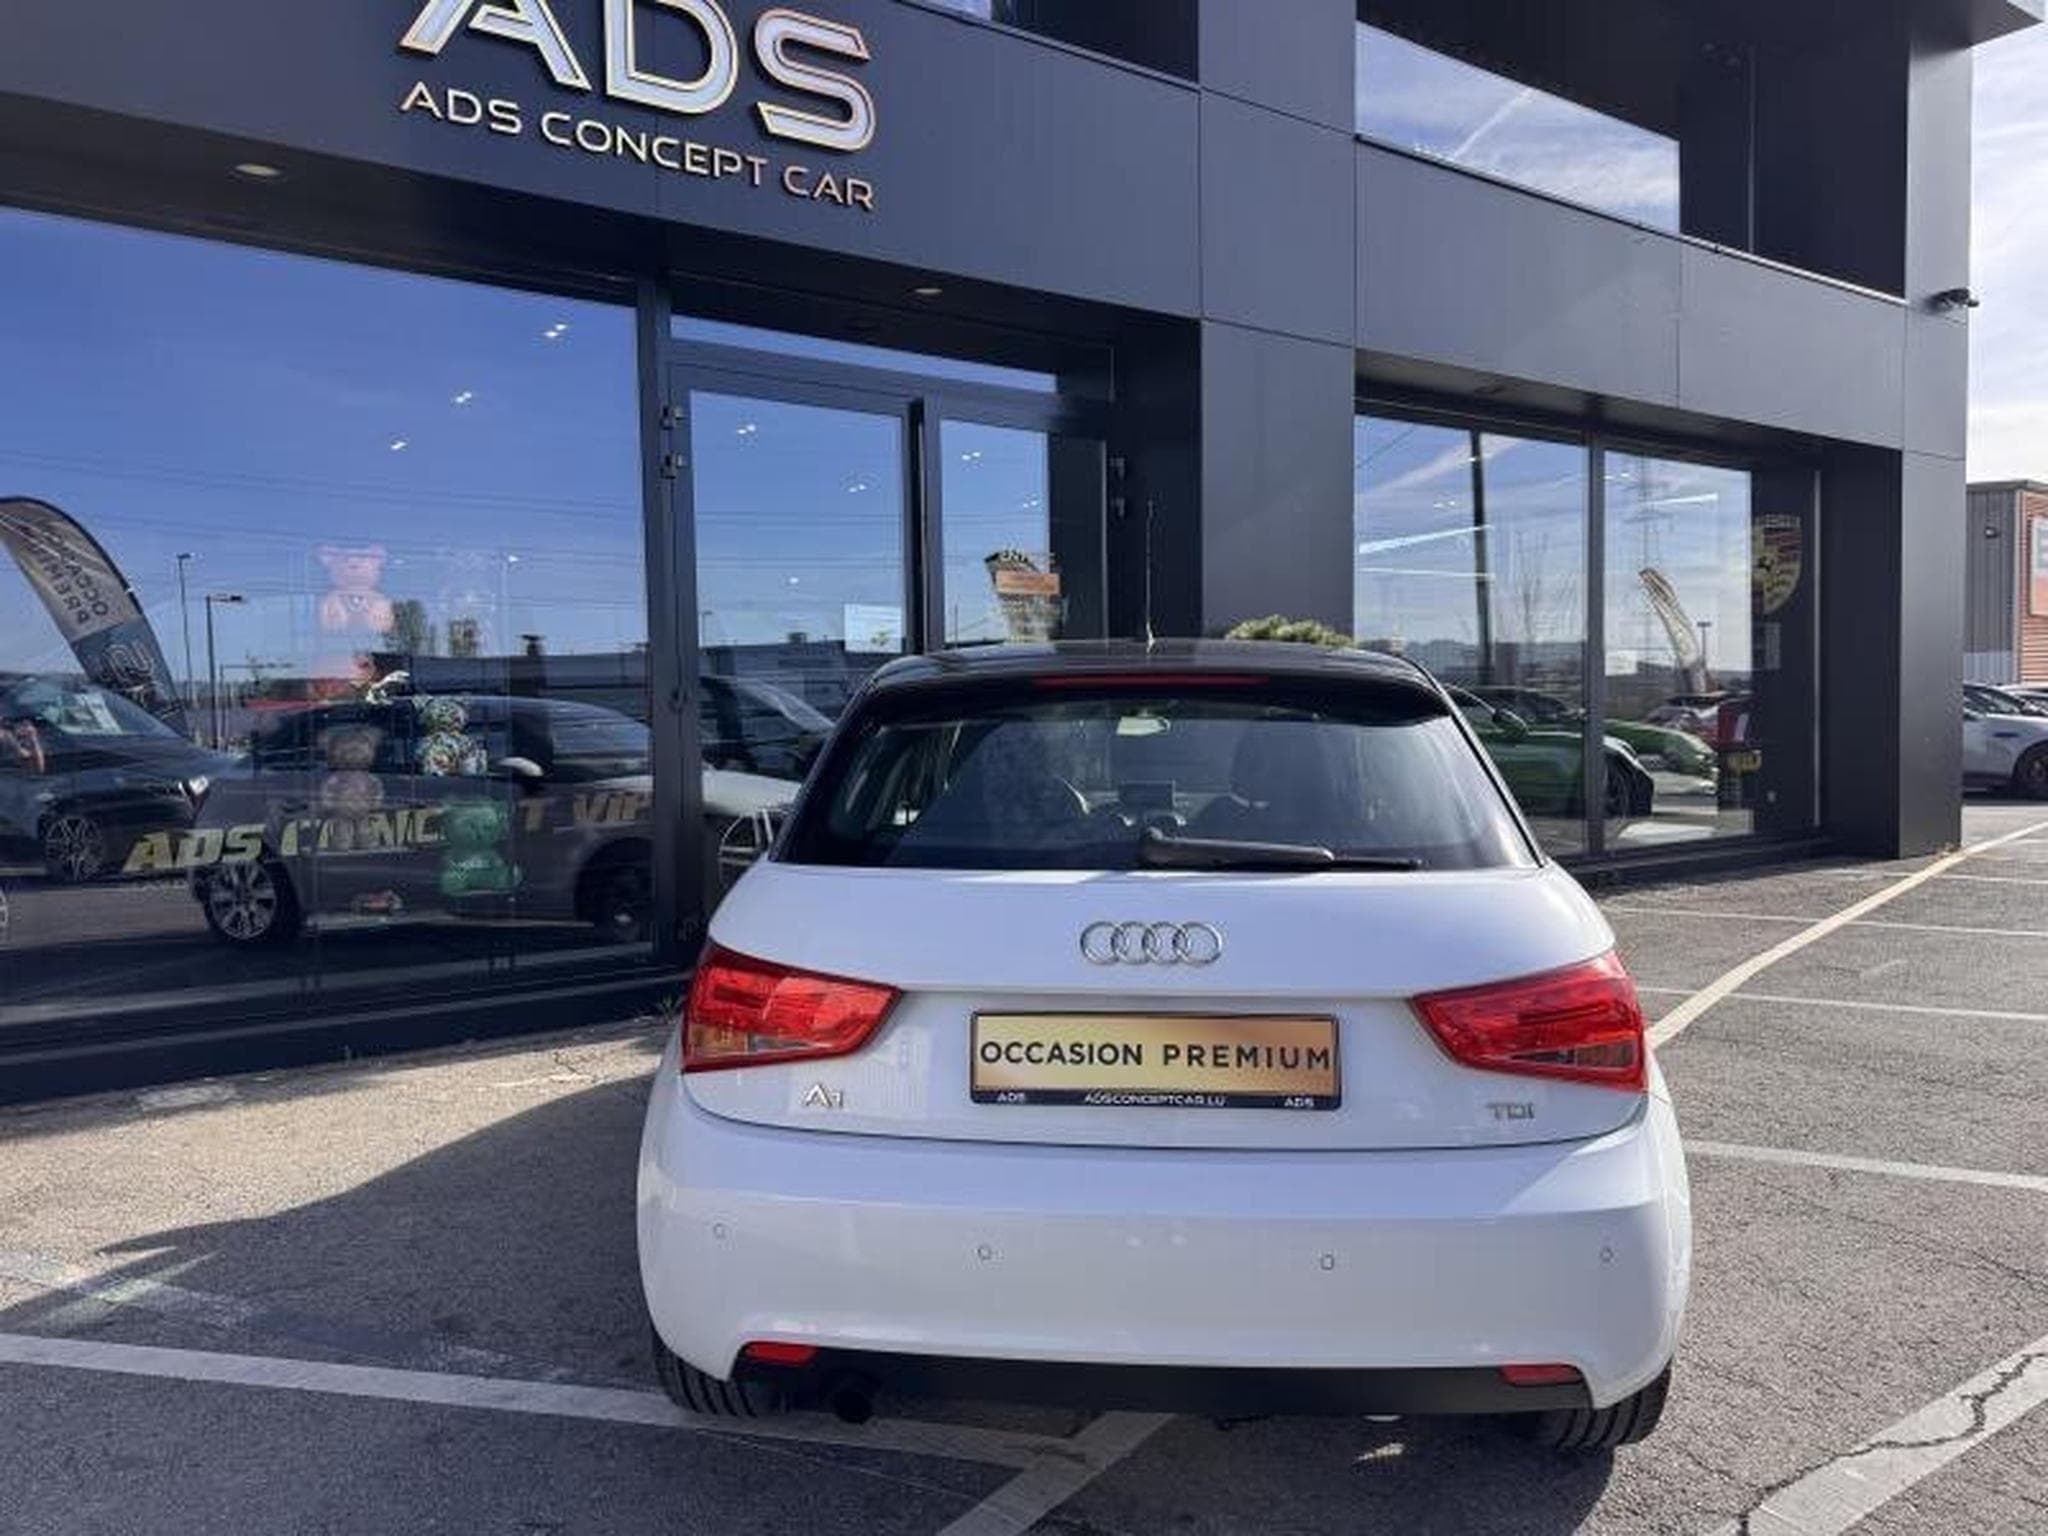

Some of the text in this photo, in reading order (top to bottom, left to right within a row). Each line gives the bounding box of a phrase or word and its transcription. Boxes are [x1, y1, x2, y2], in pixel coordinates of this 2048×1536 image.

[399, 0, 876, 152] ADS
[401, 81, 875, 211] ADS CONCEPT CAR
[121, 824, 266, 873] ADS
[980, 1040, 1330, 1070] OCCASION PREMIUM
[805, 1084, 843, 1109] A1
[1485, 1102, 1534, 1120] TDI
